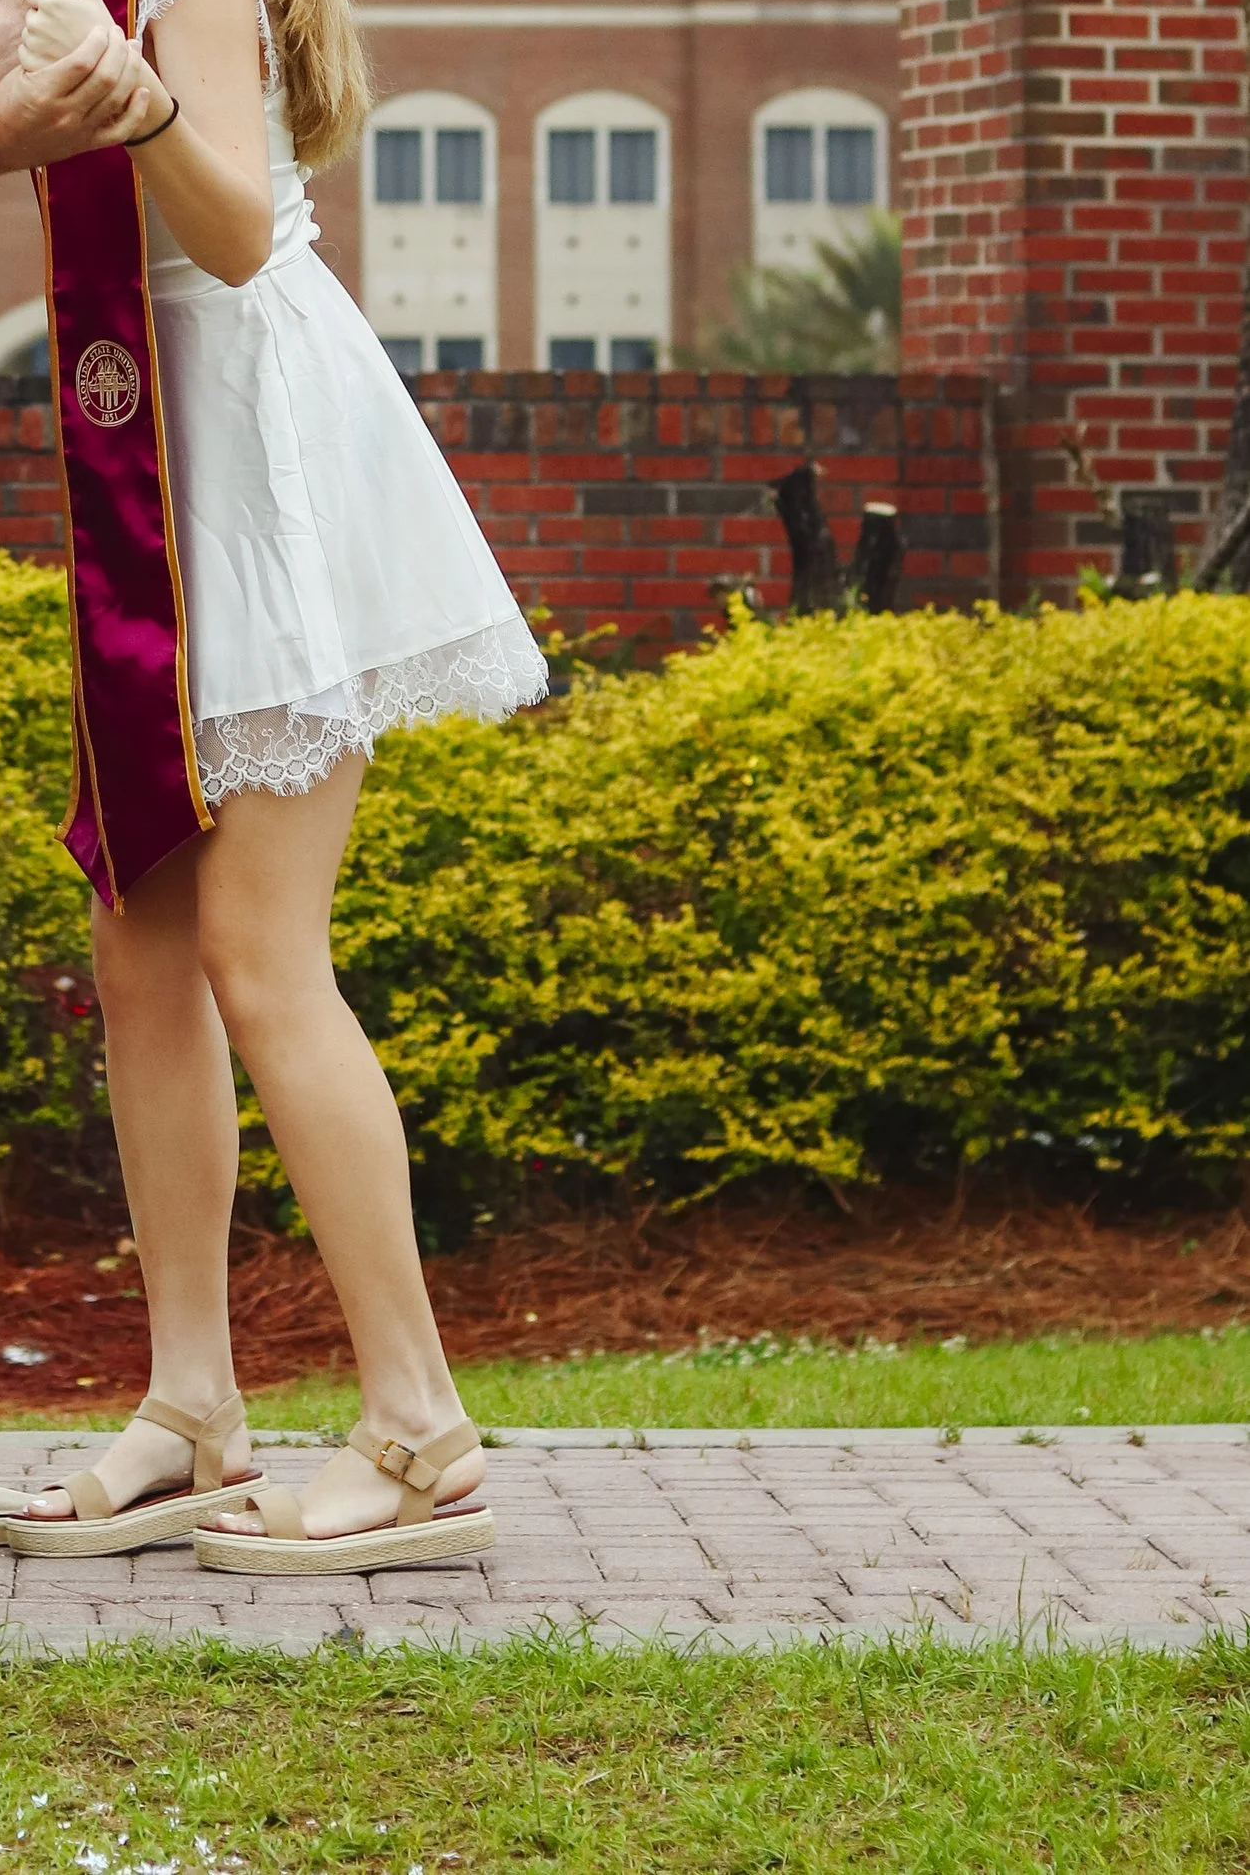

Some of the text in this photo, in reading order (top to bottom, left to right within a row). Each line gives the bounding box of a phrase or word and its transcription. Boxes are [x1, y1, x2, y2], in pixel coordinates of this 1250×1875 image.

[80, 346, 136, 406] FLORIDA STATE UNIVERSITY
[101, 413, 118, 421] 1851
